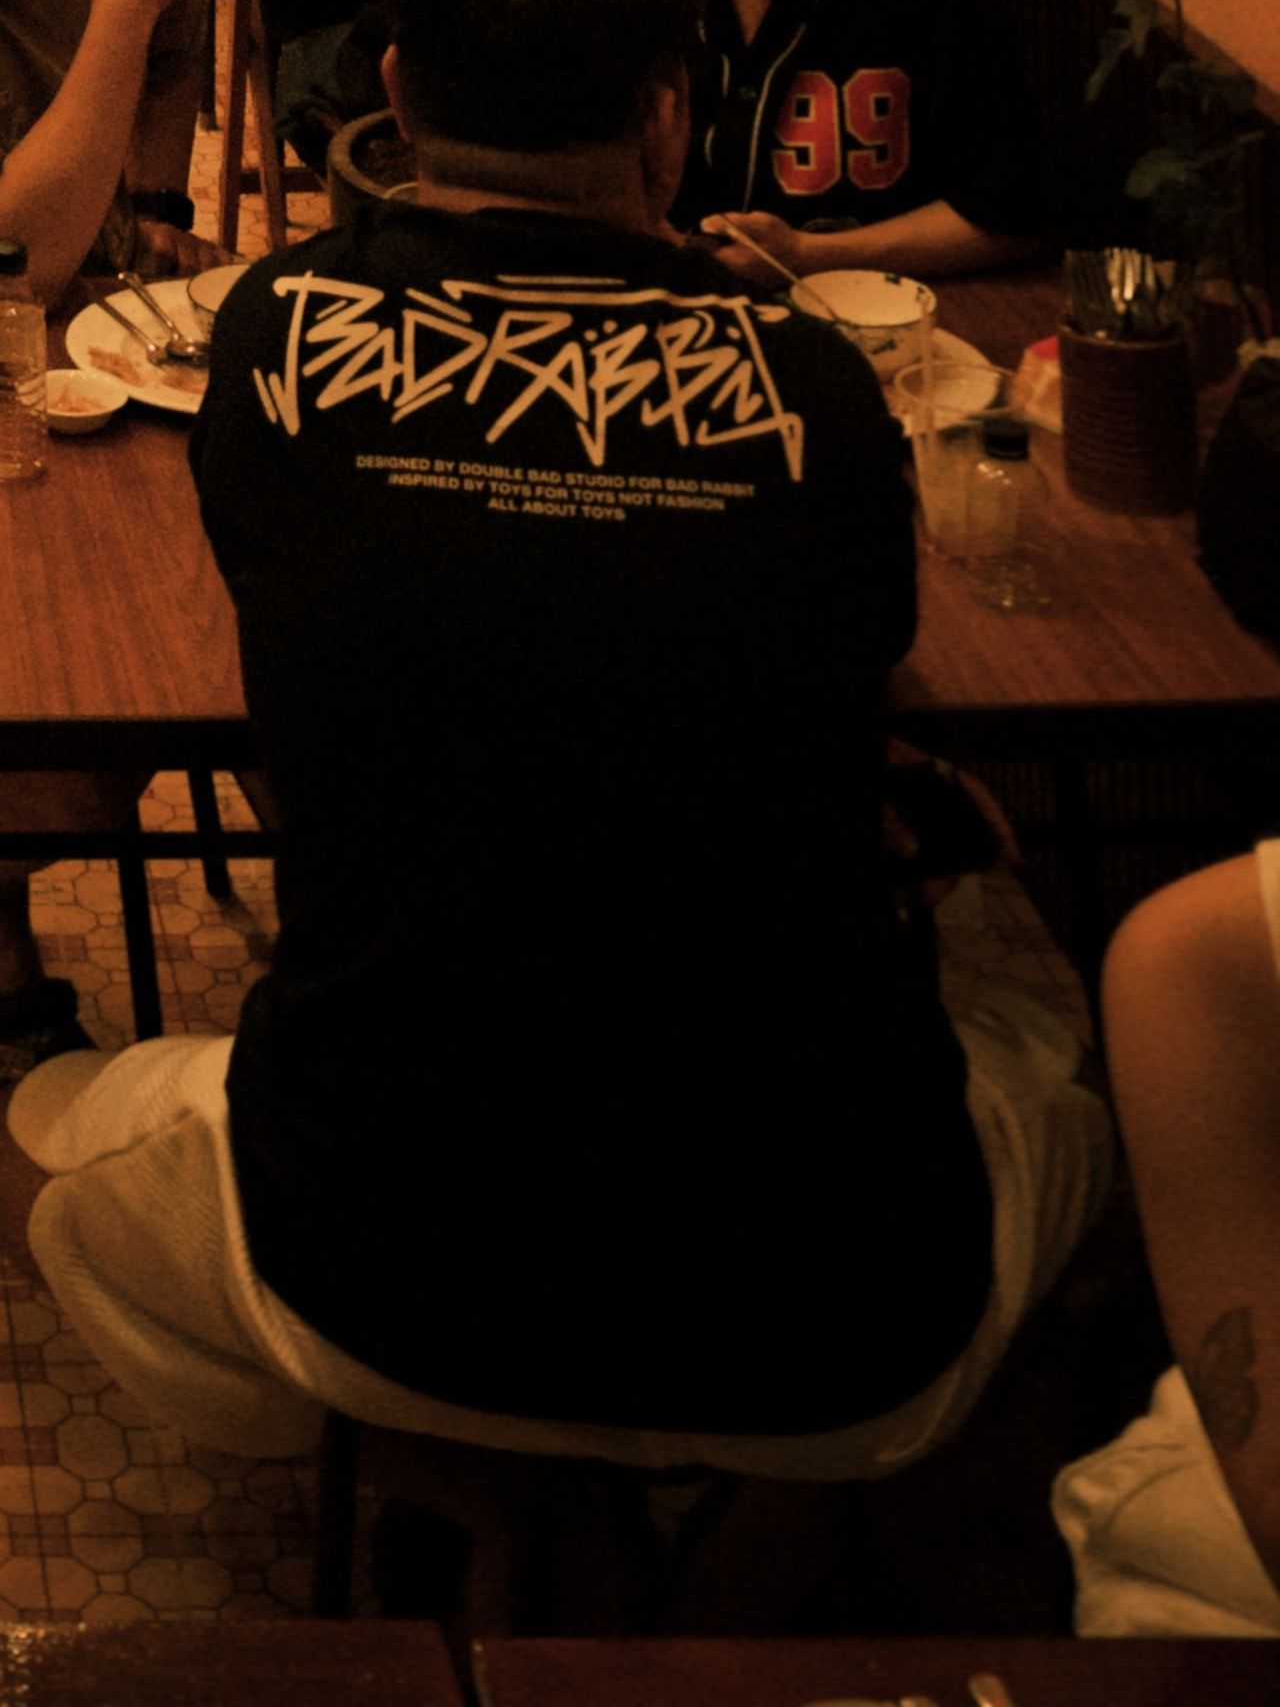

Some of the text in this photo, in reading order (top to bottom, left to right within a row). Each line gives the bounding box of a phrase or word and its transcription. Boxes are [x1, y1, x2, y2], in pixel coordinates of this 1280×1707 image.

[771, 67, 911, 197] 99
[356, 455, 755, 497] DESIGNED BY DOUBLE BAD STUDIO FOR BAD RABBIT
[388, 473, 726, 511] INSPIRED BY TOYS FOR TOYS NOT FASHION
[488, 498, 627, 521] ALL ABOUT TOYS
